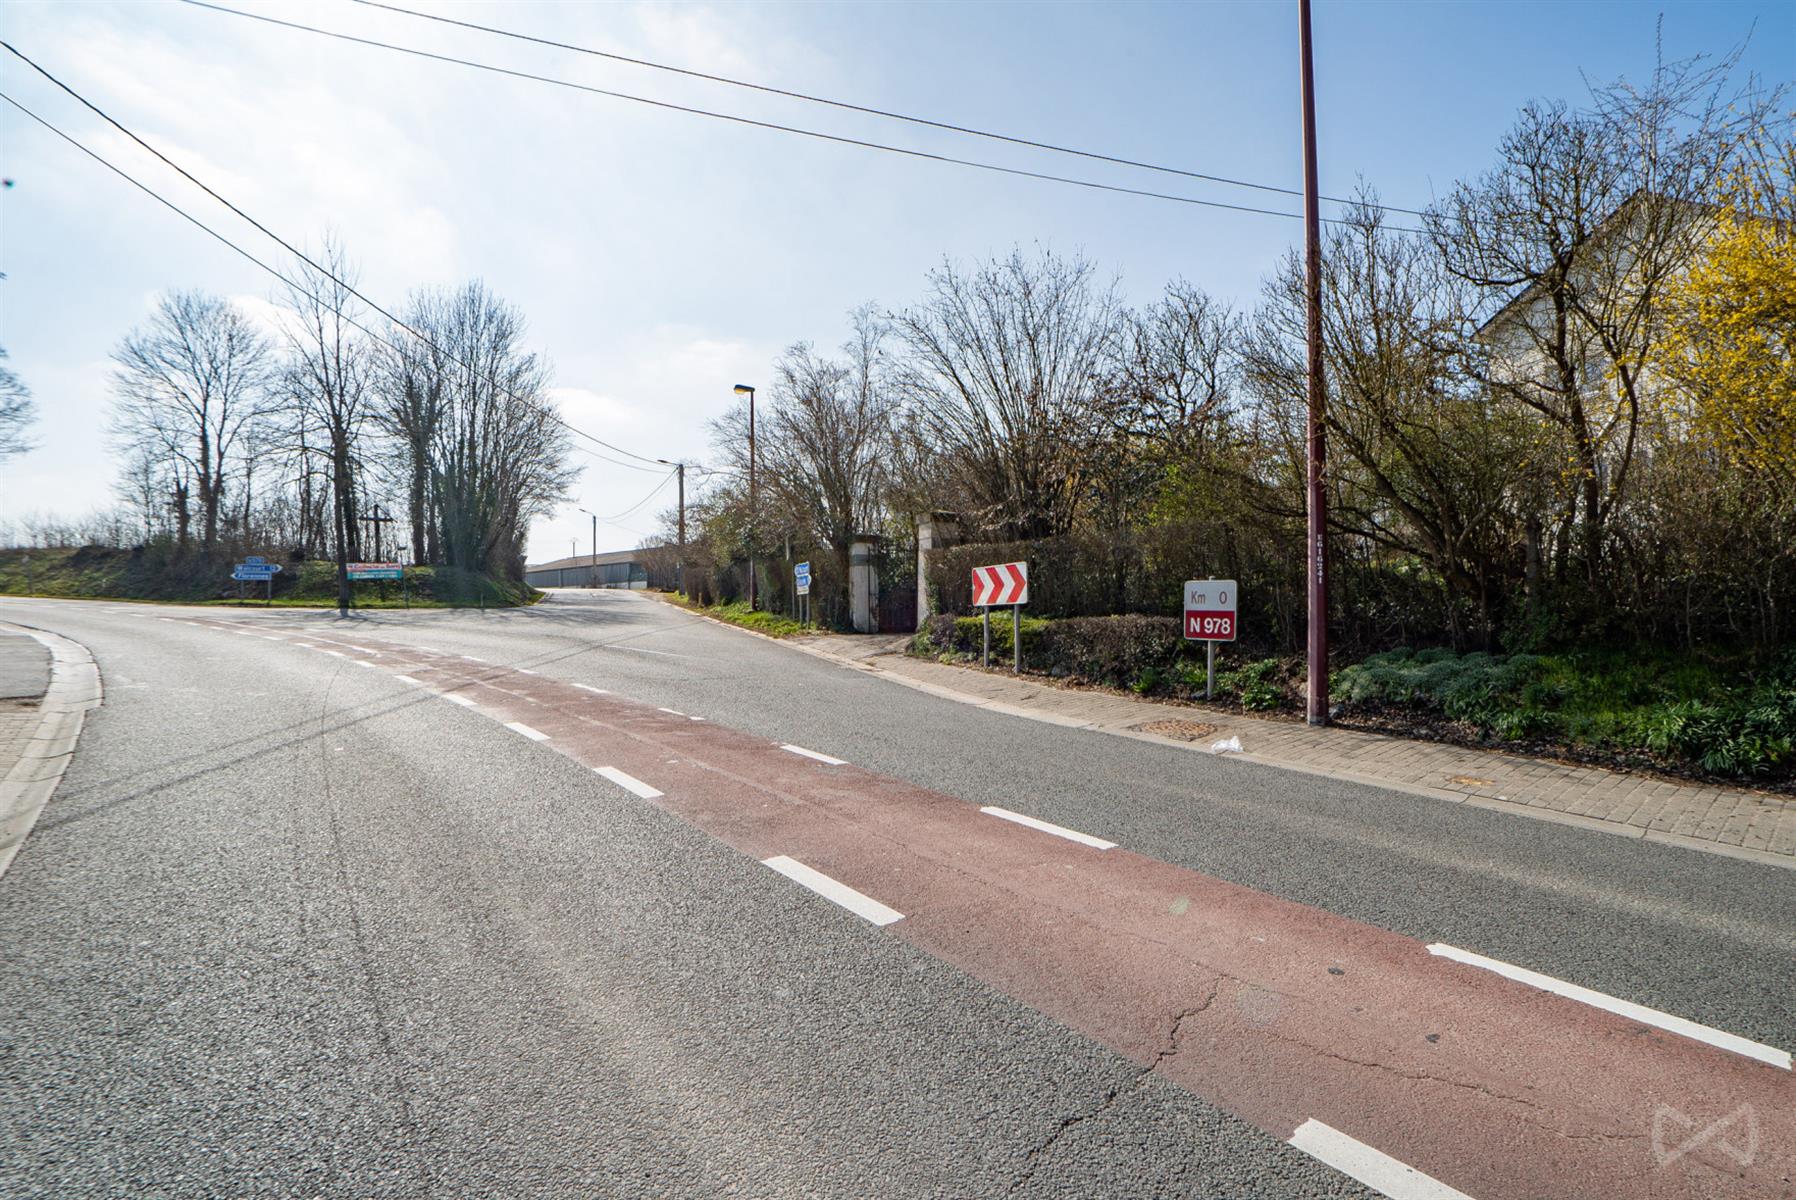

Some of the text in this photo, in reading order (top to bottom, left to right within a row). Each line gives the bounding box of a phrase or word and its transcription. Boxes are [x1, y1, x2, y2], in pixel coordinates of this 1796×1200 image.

[1191, 591, 1228, 605] Km 0
[1190, 617, 1231, 634] N 978
